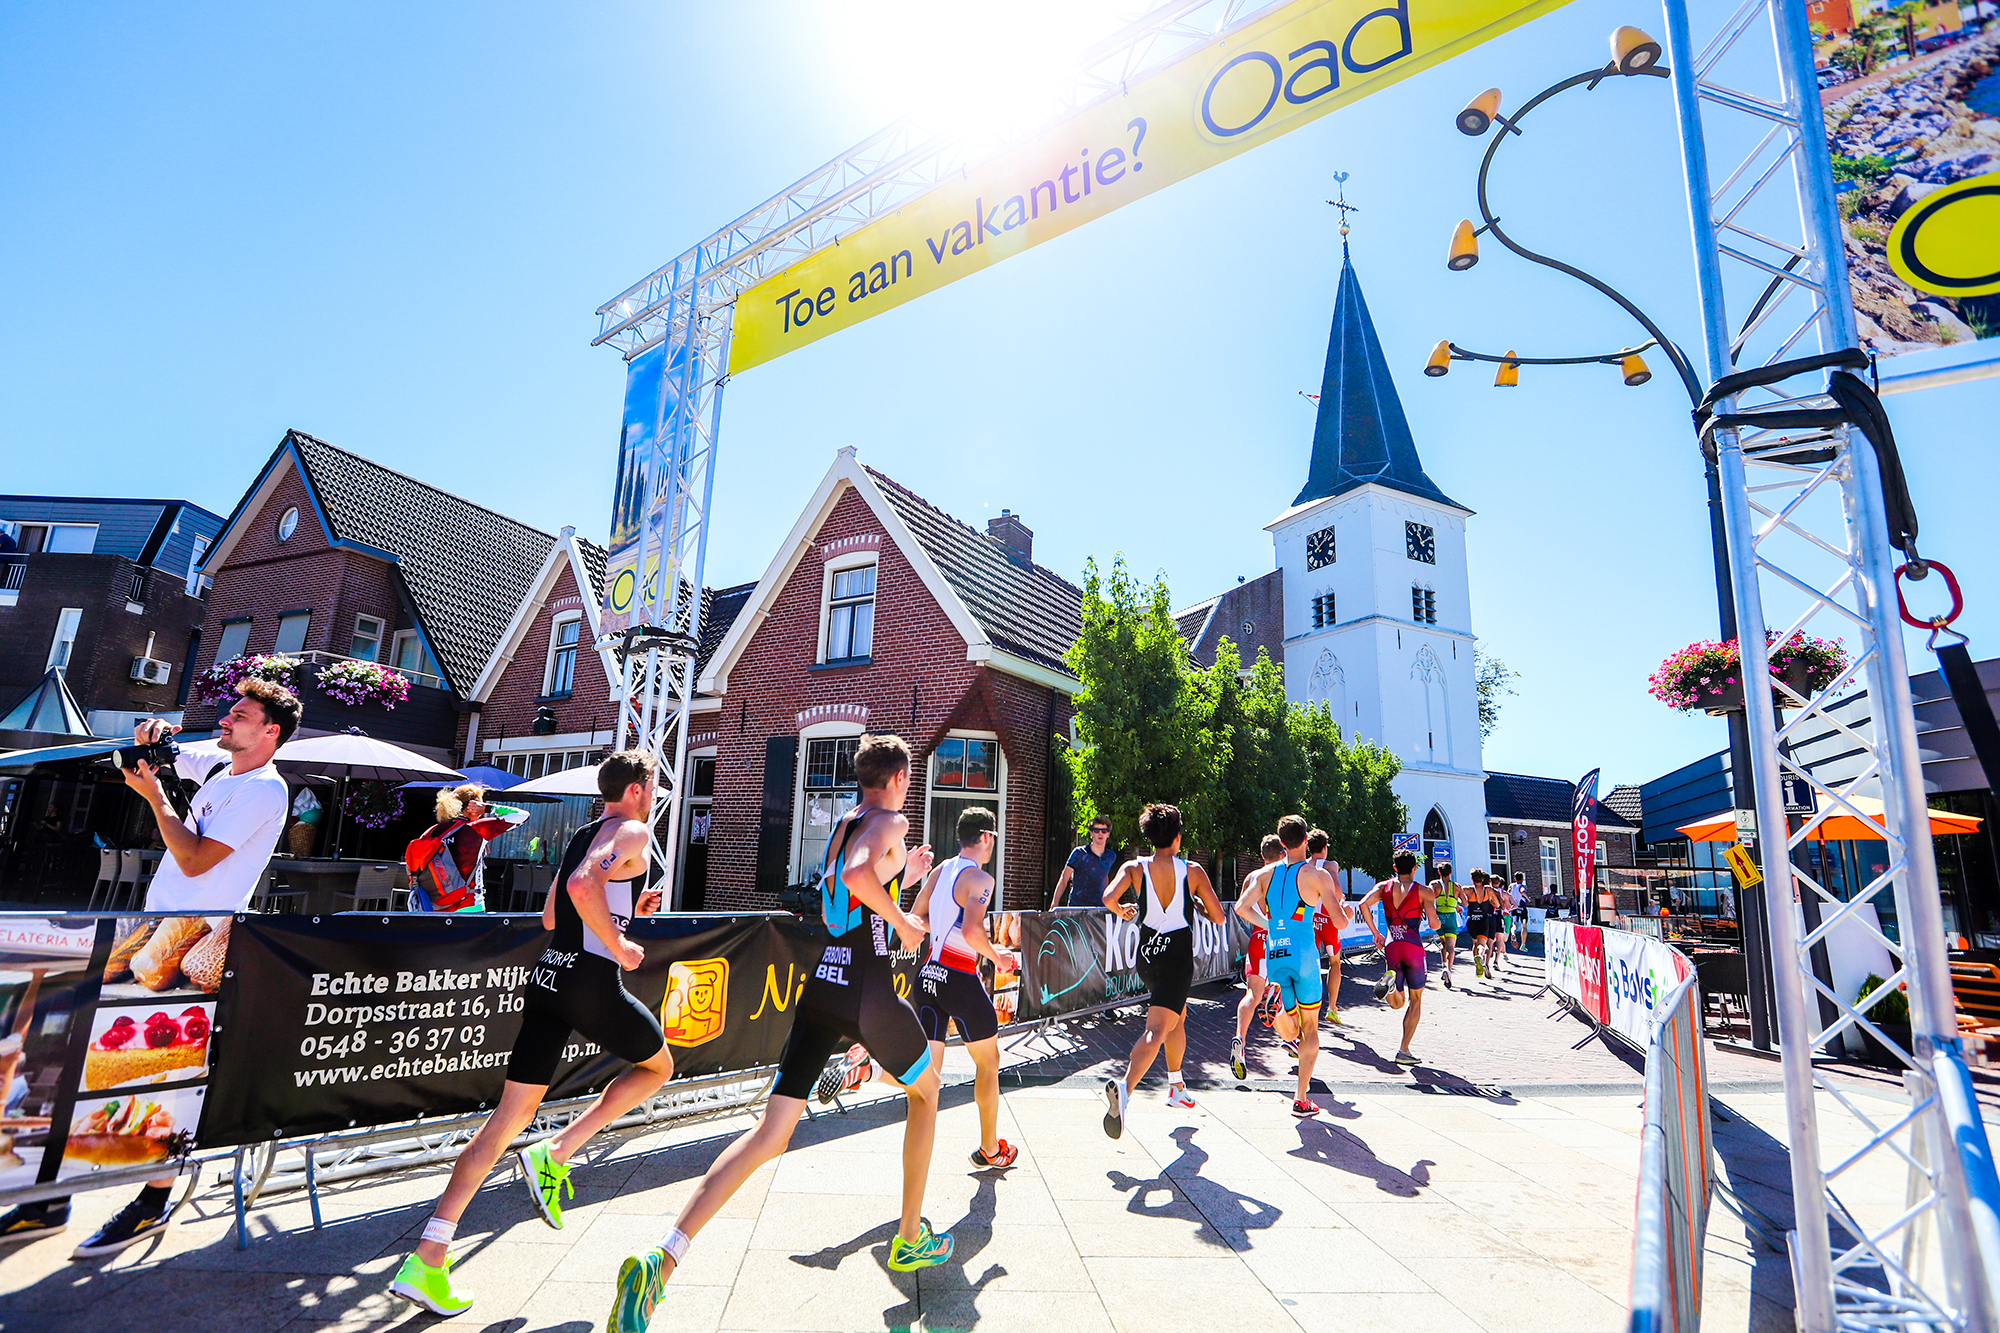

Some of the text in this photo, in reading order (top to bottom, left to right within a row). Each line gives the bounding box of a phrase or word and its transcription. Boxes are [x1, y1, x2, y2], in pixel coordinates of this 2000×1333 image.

[1201, 0, 1413, 137] Oad
[776, 117, 1148, 333] Toe aan vakantie?
[0, 929, 69, 947] ELATERIA
[1268, 948, 1292, 960] BEL
[310, 965, 531, 996] Echte Bakker Nijk
[530, 966, 558, 992] NZL
[815, 964, 849, 986] BEL
[922, 979, 937, 997] FRA
[304, 992, 525, 1028] Dorpsstraat 16, Ho
[300, 1030, 367, 1060] 0548
[389, 1026, 420, 1055] 36
[425, 1027, 455, 1051] 37
[460, 1025, 486, 1046] 03
